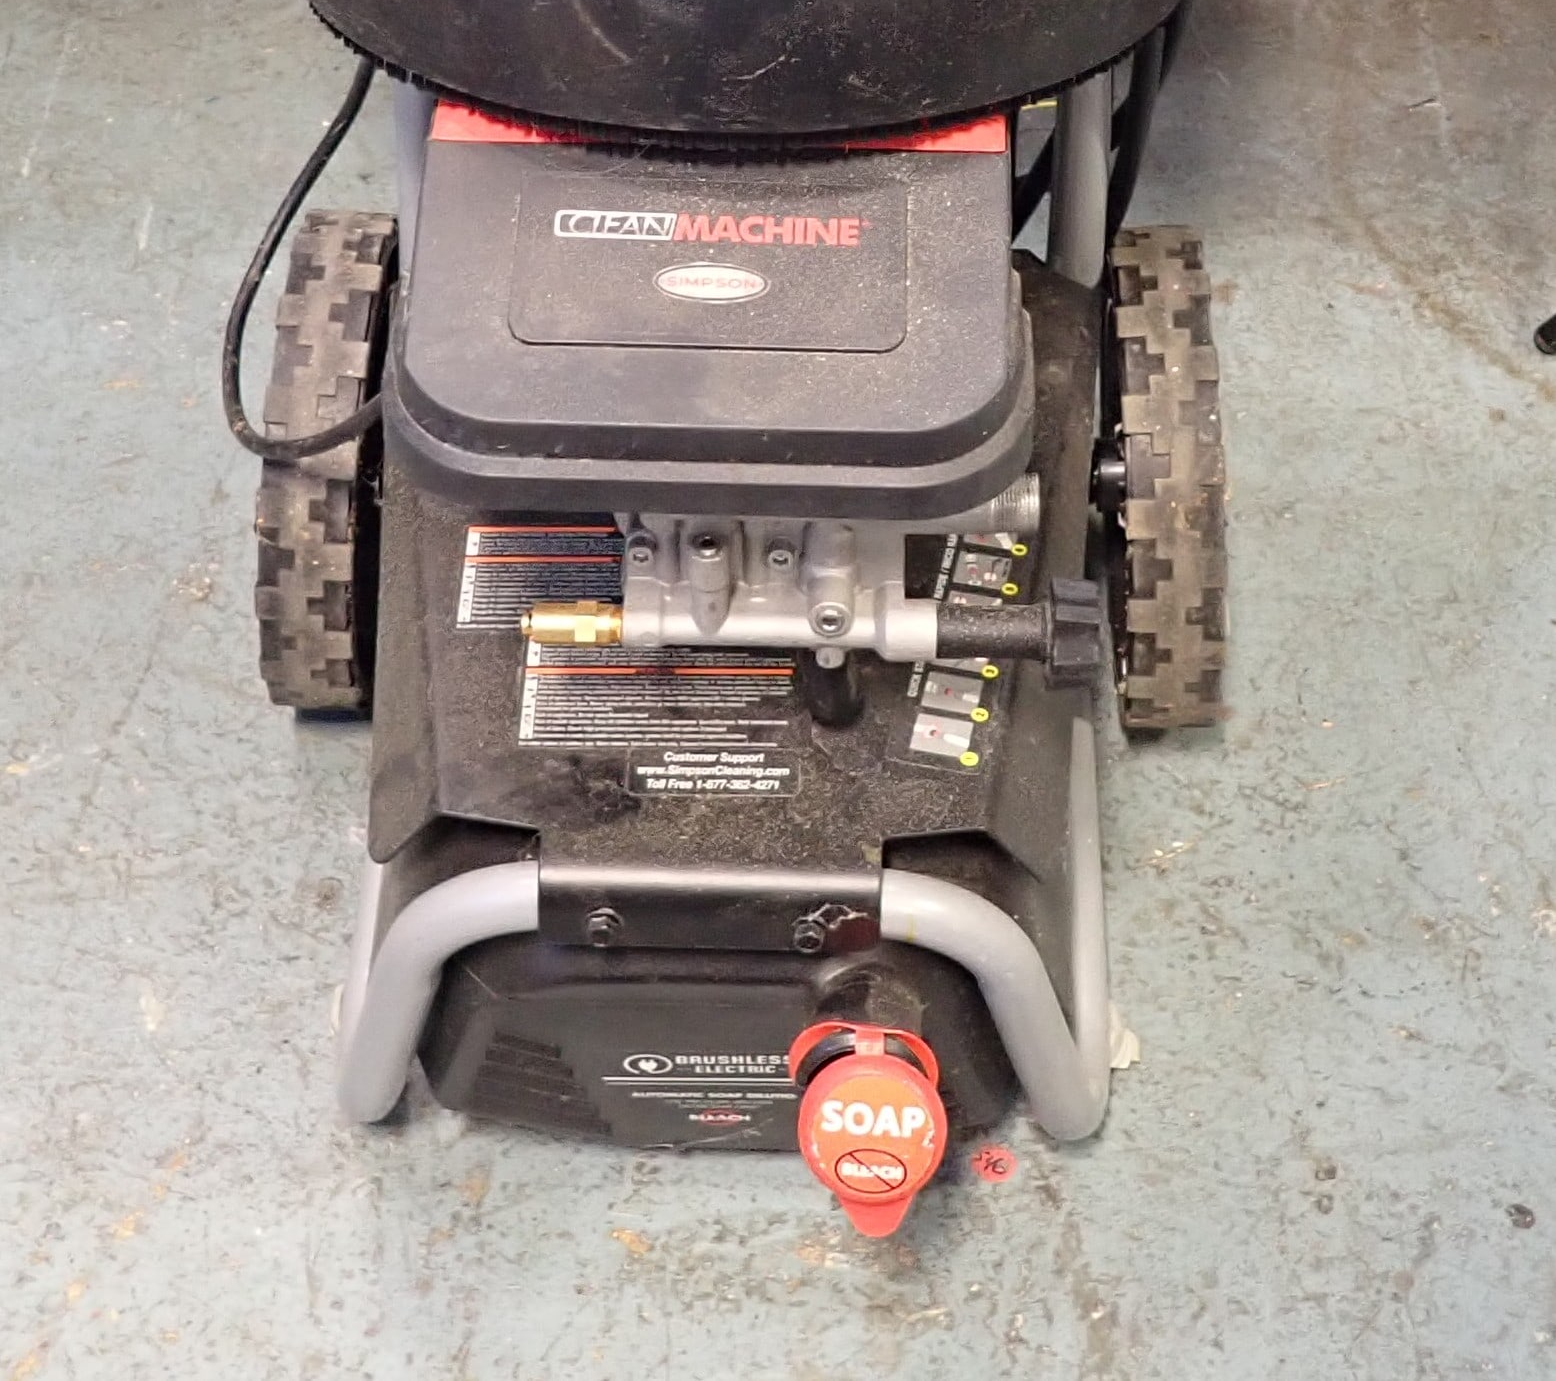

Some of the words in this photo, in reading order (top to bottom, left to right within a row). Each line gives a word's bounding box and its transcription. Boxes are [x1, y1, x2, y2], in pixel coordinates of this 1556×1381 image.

[666, 276, 757, 290] SIMPSON
[663, 752, 718, 762] Customer
[719, 752, 765, 764] Support
[636, 765, 791, 777] www.SimpsonCleaning.com
[646, 778, 666, 789] Toll
[667, 779, 693, 789] Free
[694, 1065, 776, 1074] ELECTRIC
[821, 1099, 926, 1138] SOAP
[840, 1162, 904, 1180] BLEACH
